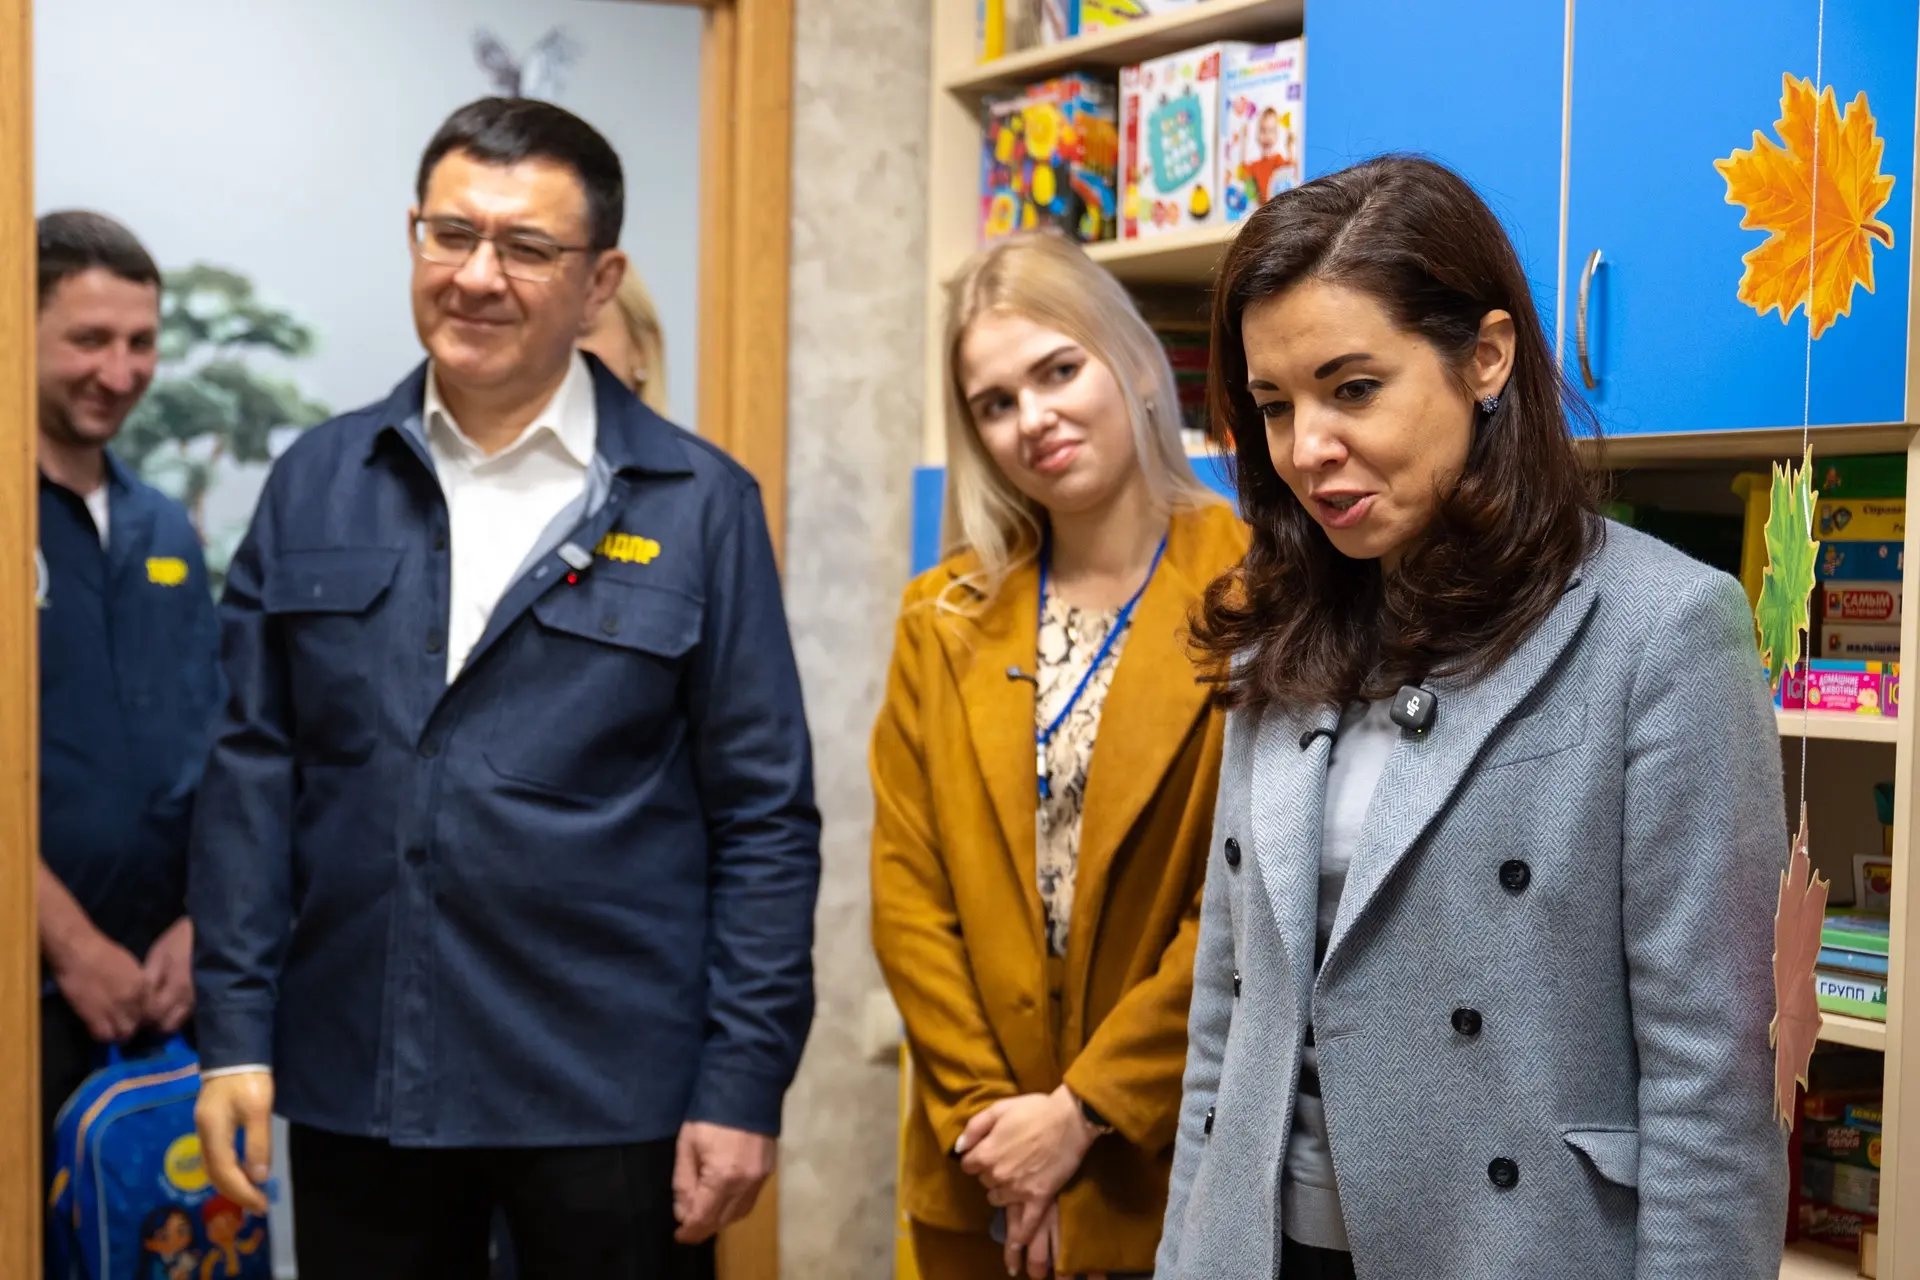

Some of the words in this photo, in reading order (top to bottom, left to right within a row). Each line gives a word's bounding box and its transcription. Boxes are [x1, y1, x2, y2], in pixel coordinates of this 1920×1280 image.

[1843, 592, 1891, 608] САМЫМ
[1818, 673, 1859, 687] ДОМАШНИЕ
[1820, 981, 1865, 1002] ГРУПП
